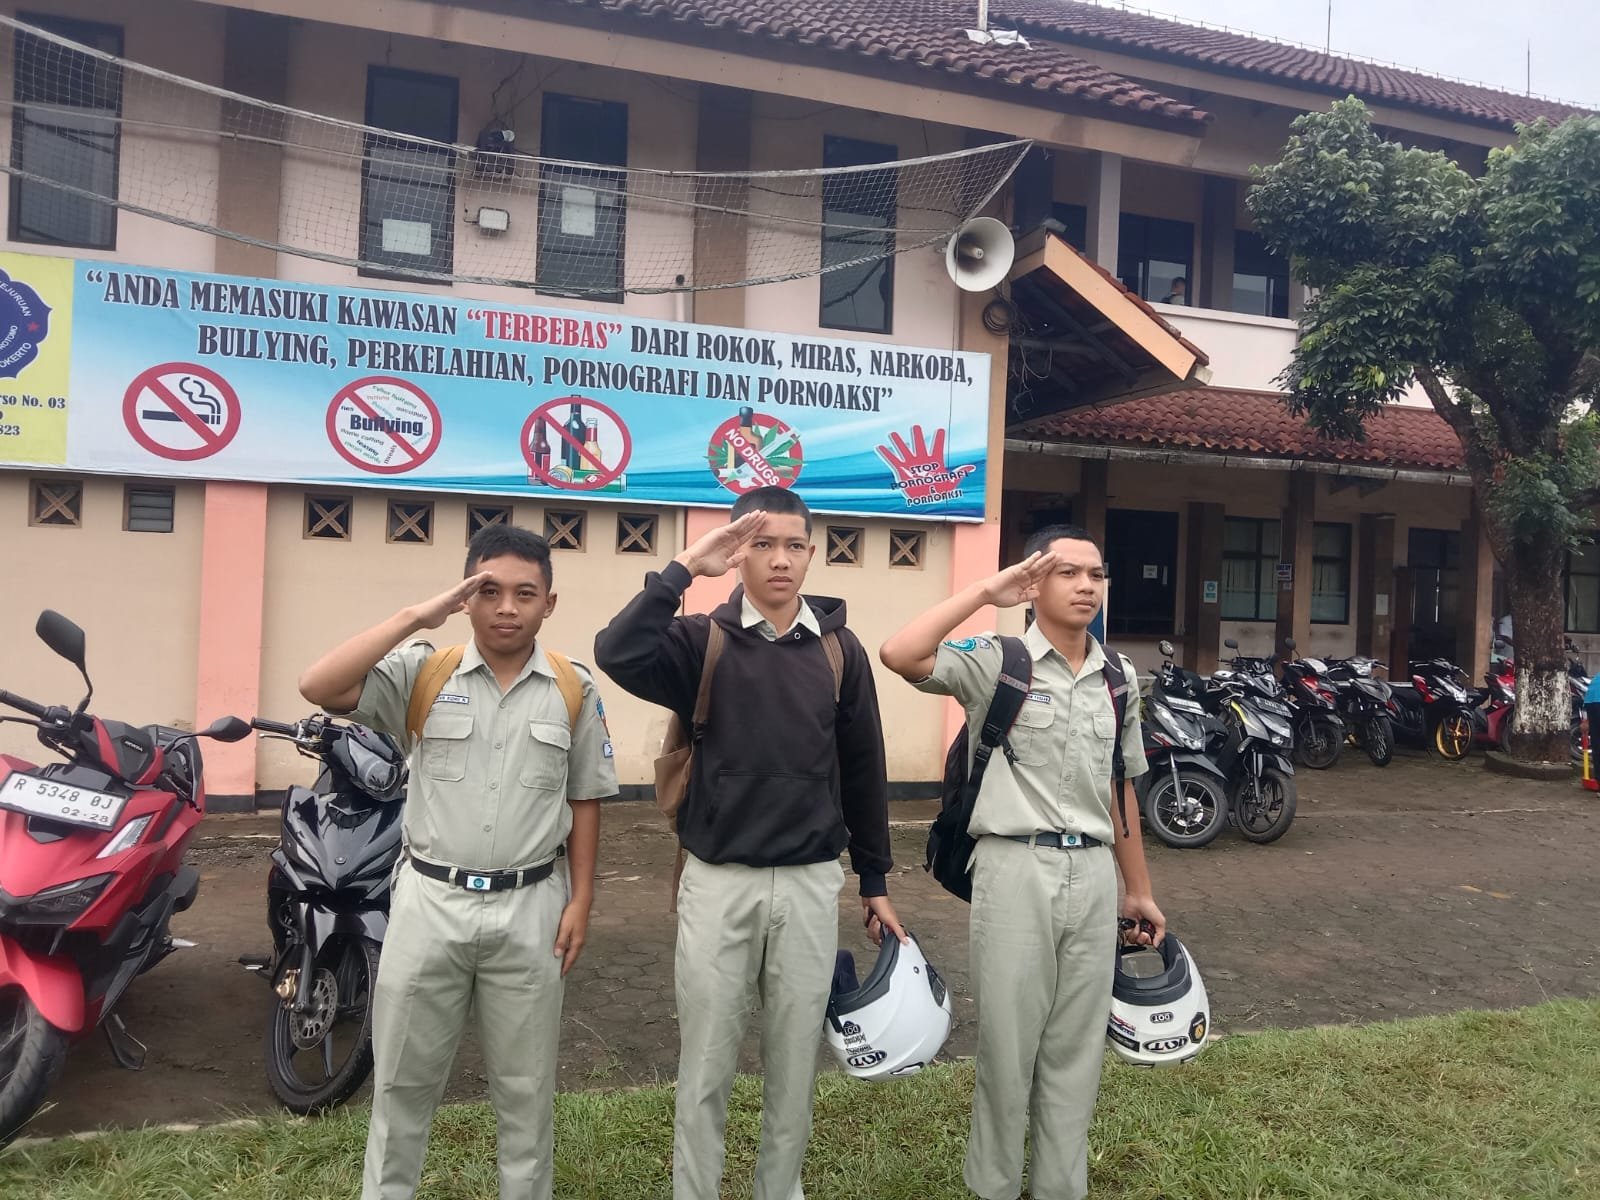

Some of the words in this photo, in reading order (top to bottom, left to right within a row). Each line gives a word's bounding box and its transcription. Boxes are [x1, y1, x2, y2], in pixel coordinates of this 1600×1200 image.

[86, 269, 180, 309] “ANDA
[190, 280, 329, 323] MEMASUKI
[337, 295, 457, 335] KAWASAN
[467, 308, 622, 349] “TERBEBAS”
[630, 325, 689, 358] DARI
[696, 332, 783, 370] ROKOK,
[791, 342, 861, 377] MIRAS,
[870, 350, 974, 386] NARKOBA,
[197, 324, 336, 369] BULLYING,
[347, 338, 533, 386] PERKELAHIAN,
[543, 356, 698, 397] PORNOGRAFI
[707, 371, 751, 402] DAN
[757, 378, 893, 412] PORNOAKSI”
[22, 394, 43, 407] No.
[48, 397, 66, 409] 03
[350, 414, 423, 436] Bullying
[725, 428, 745, 447] NO
[741, 446, 780, 486] DRUGS
[911, 462, 939, 474] STOP
[890, 470, 969, 490] PORNOGRAFI
[907, 490, 962, 507] PORNOAKSI
[14, 778, 27, 791] R
[36, 783, 80, 802] 5348
[1148, 1038, 1187, 1051] KYT
[852, 1051, 885, 1067] KYT
